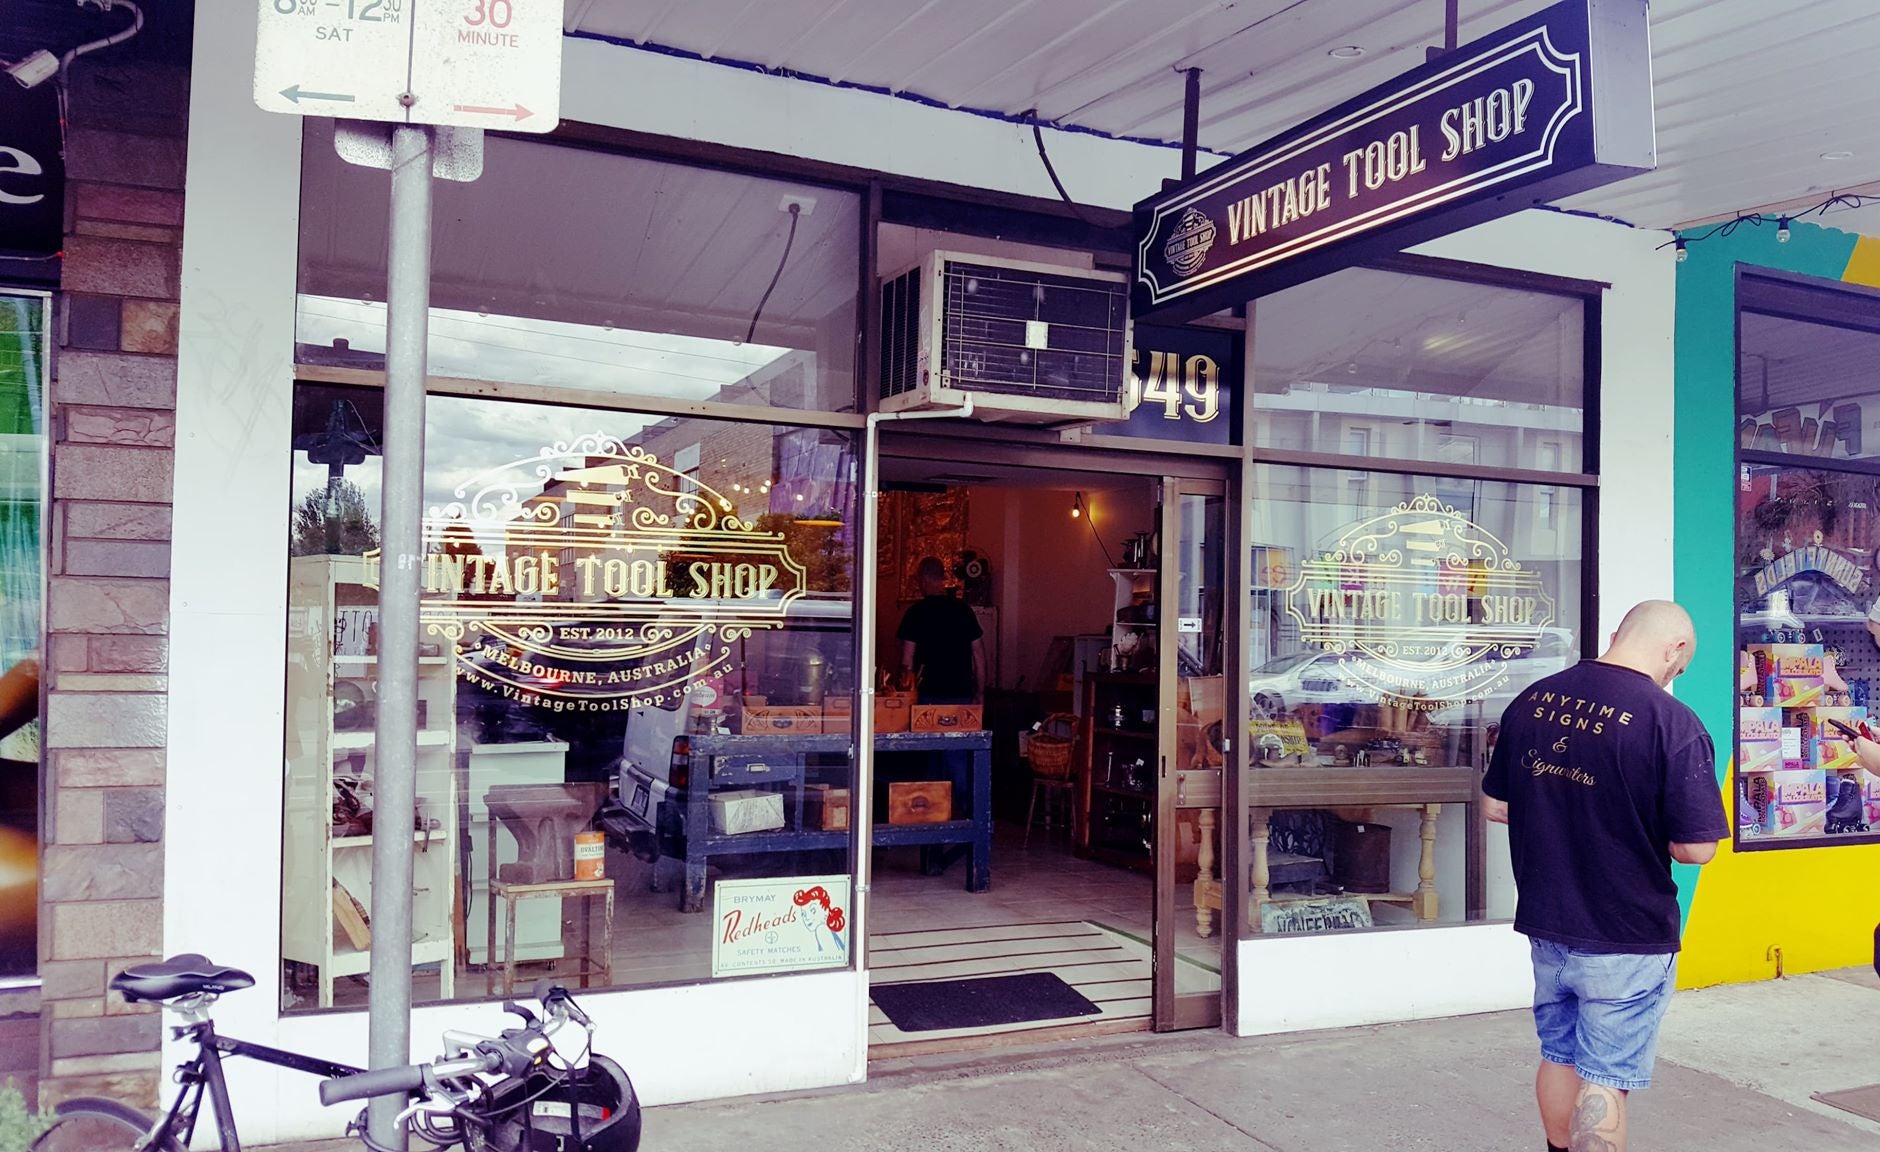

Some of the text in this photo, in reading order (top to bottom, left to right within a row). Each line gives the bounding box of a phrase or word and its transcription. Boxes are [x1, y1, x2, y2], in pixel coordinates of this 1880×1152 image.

[383, 12, 400, 23] PM
[463, 0, 512, 28] 30
[315, 27, 353, 43] SAT
[458, 29, 519, 48] MINUTE
[1226, 78, 1535, 246] VINTAGE TOOL SHOP
[421, 552, 560, 596] INTAGE
[576, 557, 673, 598] TOOL
[689, 561, 779, 600] SHOP
[1306, 588, 1537, 624] VINTAGE TOOL SHOP
[559, 627, 634, 640] EST. 2012
[1402, 645, 1449, 656] EST. 2012
[481, 645, 706, 687] MELBOURNE, AUSTRALIA
[1355, 657, 1492, 691] MELBOURNE, AUSTRALIA
[1529, 691, 1633, 725] ANYTIME
[1533, 707, 1605, 735] SIGNS
[1552, 736, 1569, 753] &
[1521, 748, 1598, 786] Signwriters
[733, 894, 776, 904] BRYMAY
[723, 905, 797, 944] Redheads
[737, 945, 801, 957] SAFETY MATCHES
